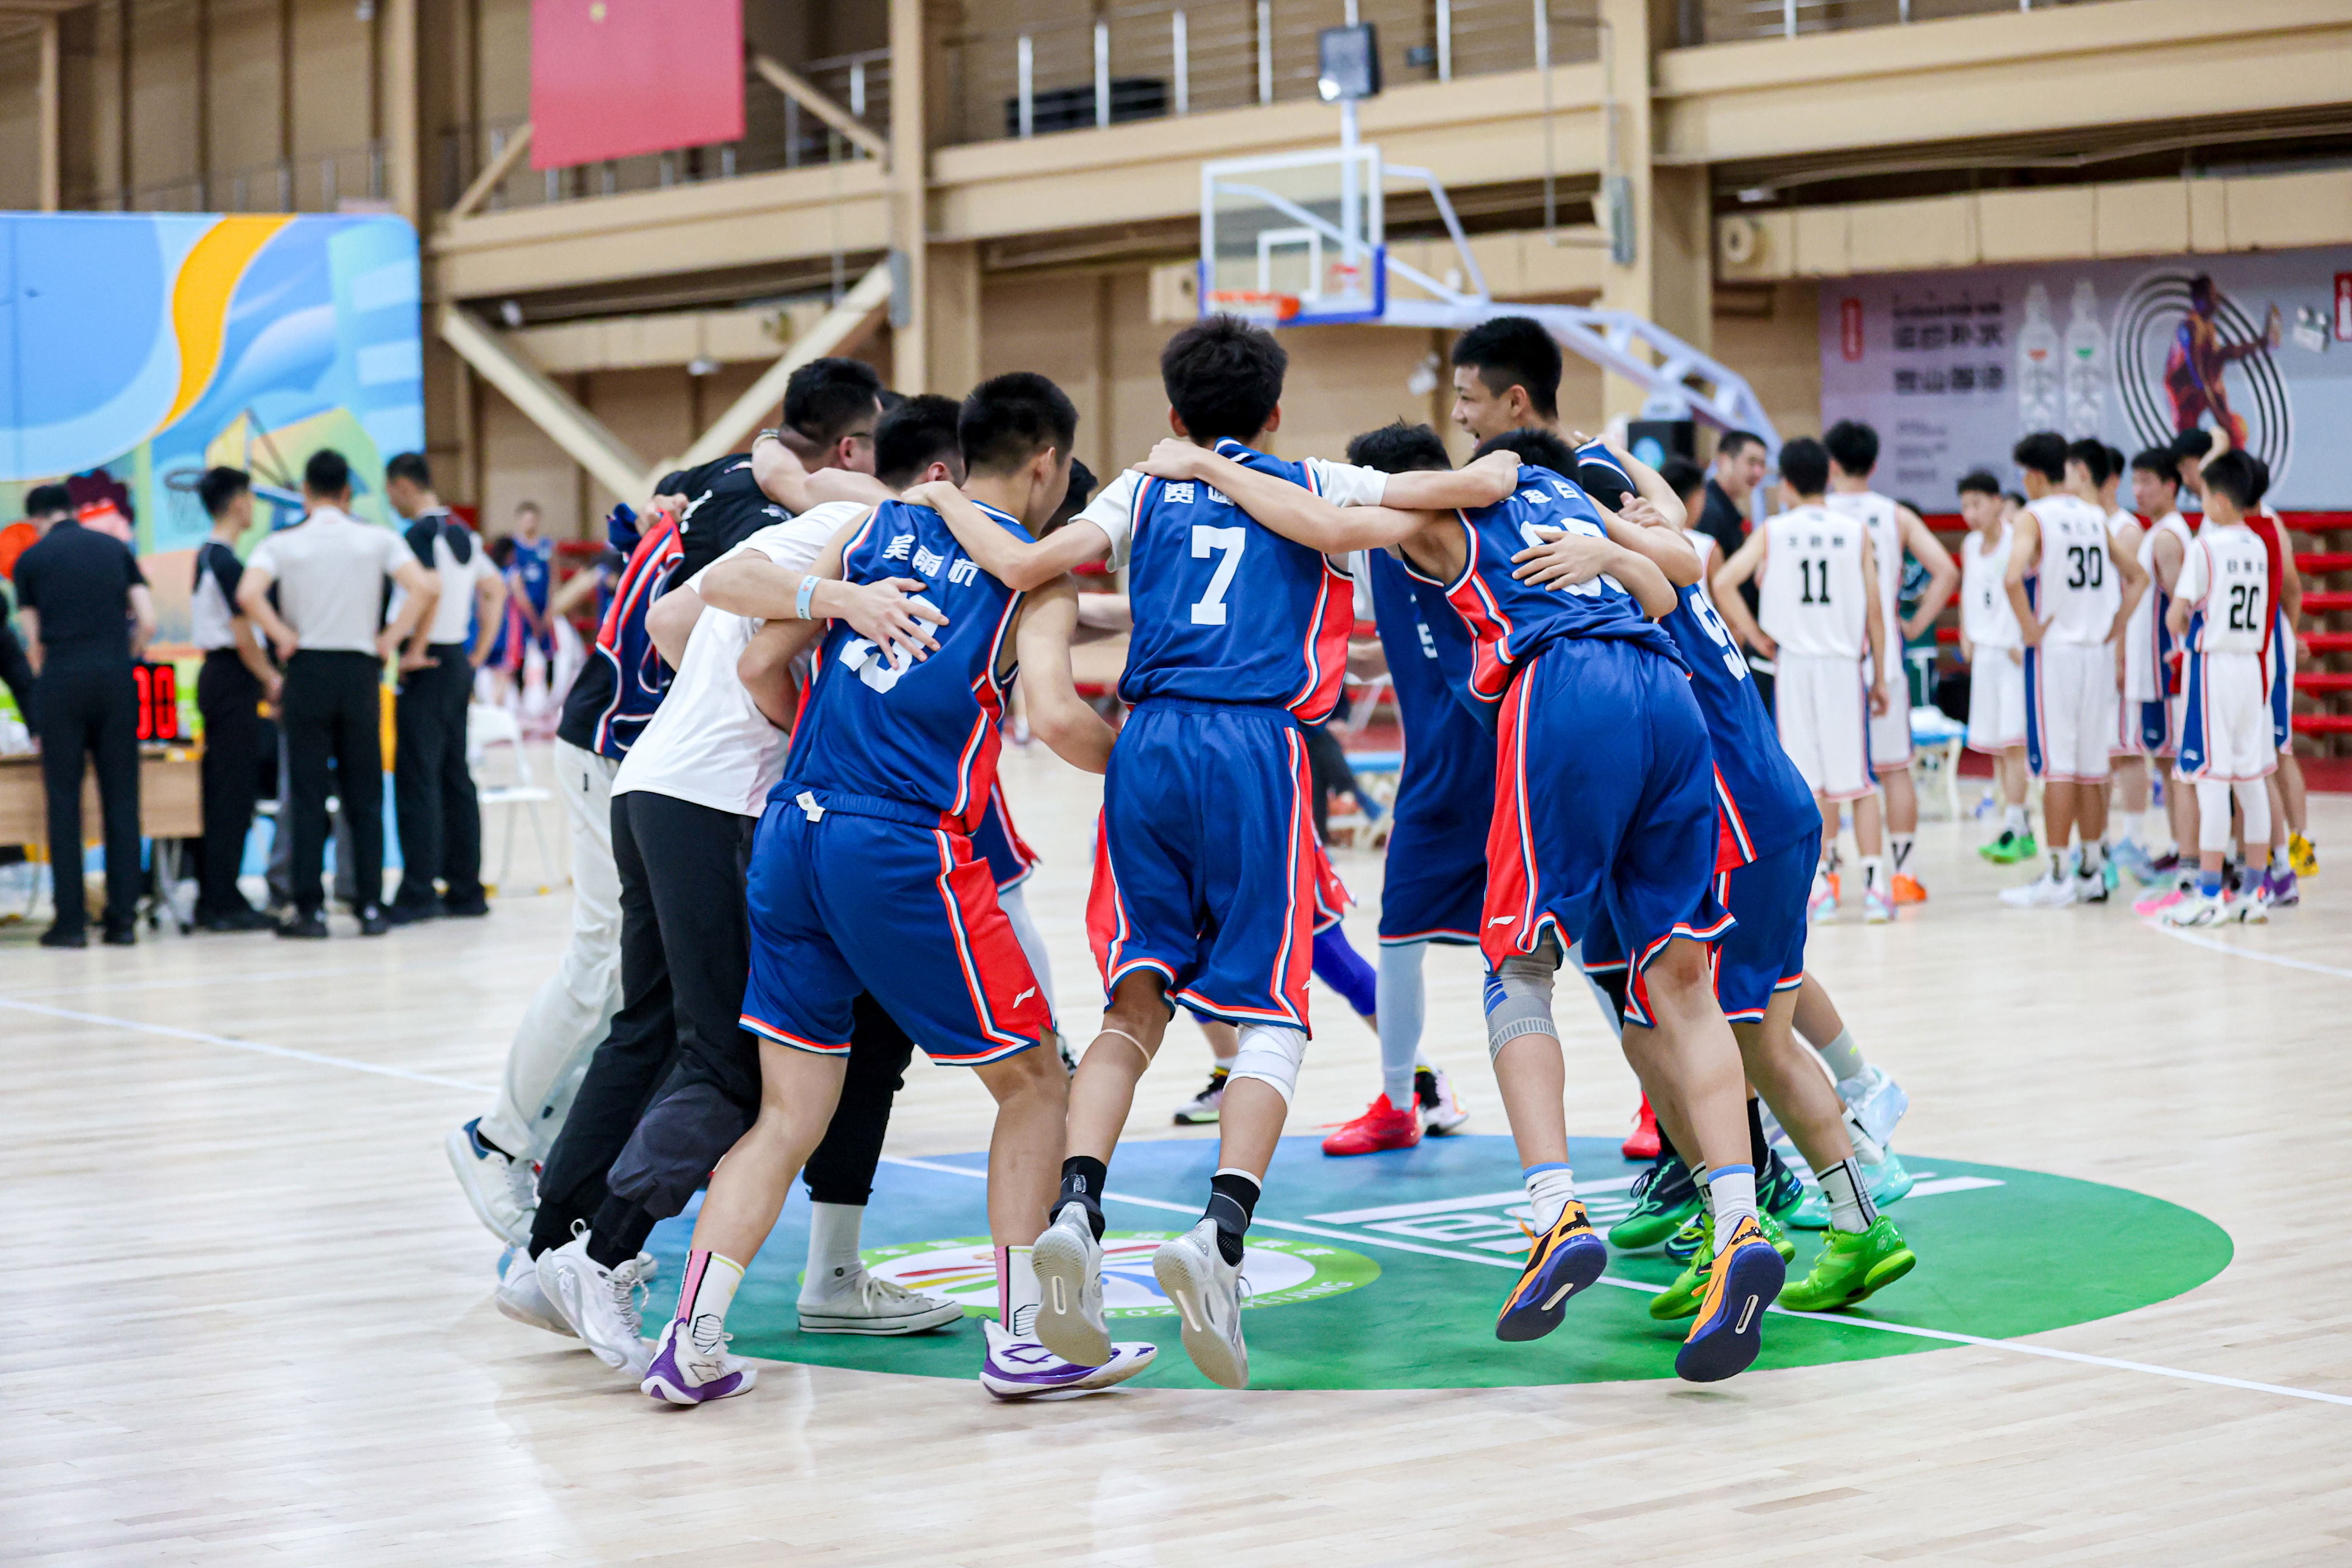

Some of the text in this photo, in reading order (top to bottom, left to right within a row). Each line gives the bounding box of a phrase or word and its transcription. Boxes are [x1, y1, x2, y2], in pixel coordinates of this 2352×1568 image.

[882, 534, 980, 587] 吴雨杭
[1191, 525, 1245, 625] 7
[1801, 560, 1830, 603] 11
[2068, 546, 2102, 588] 30
[2231, 585, 2260, 630] 20
